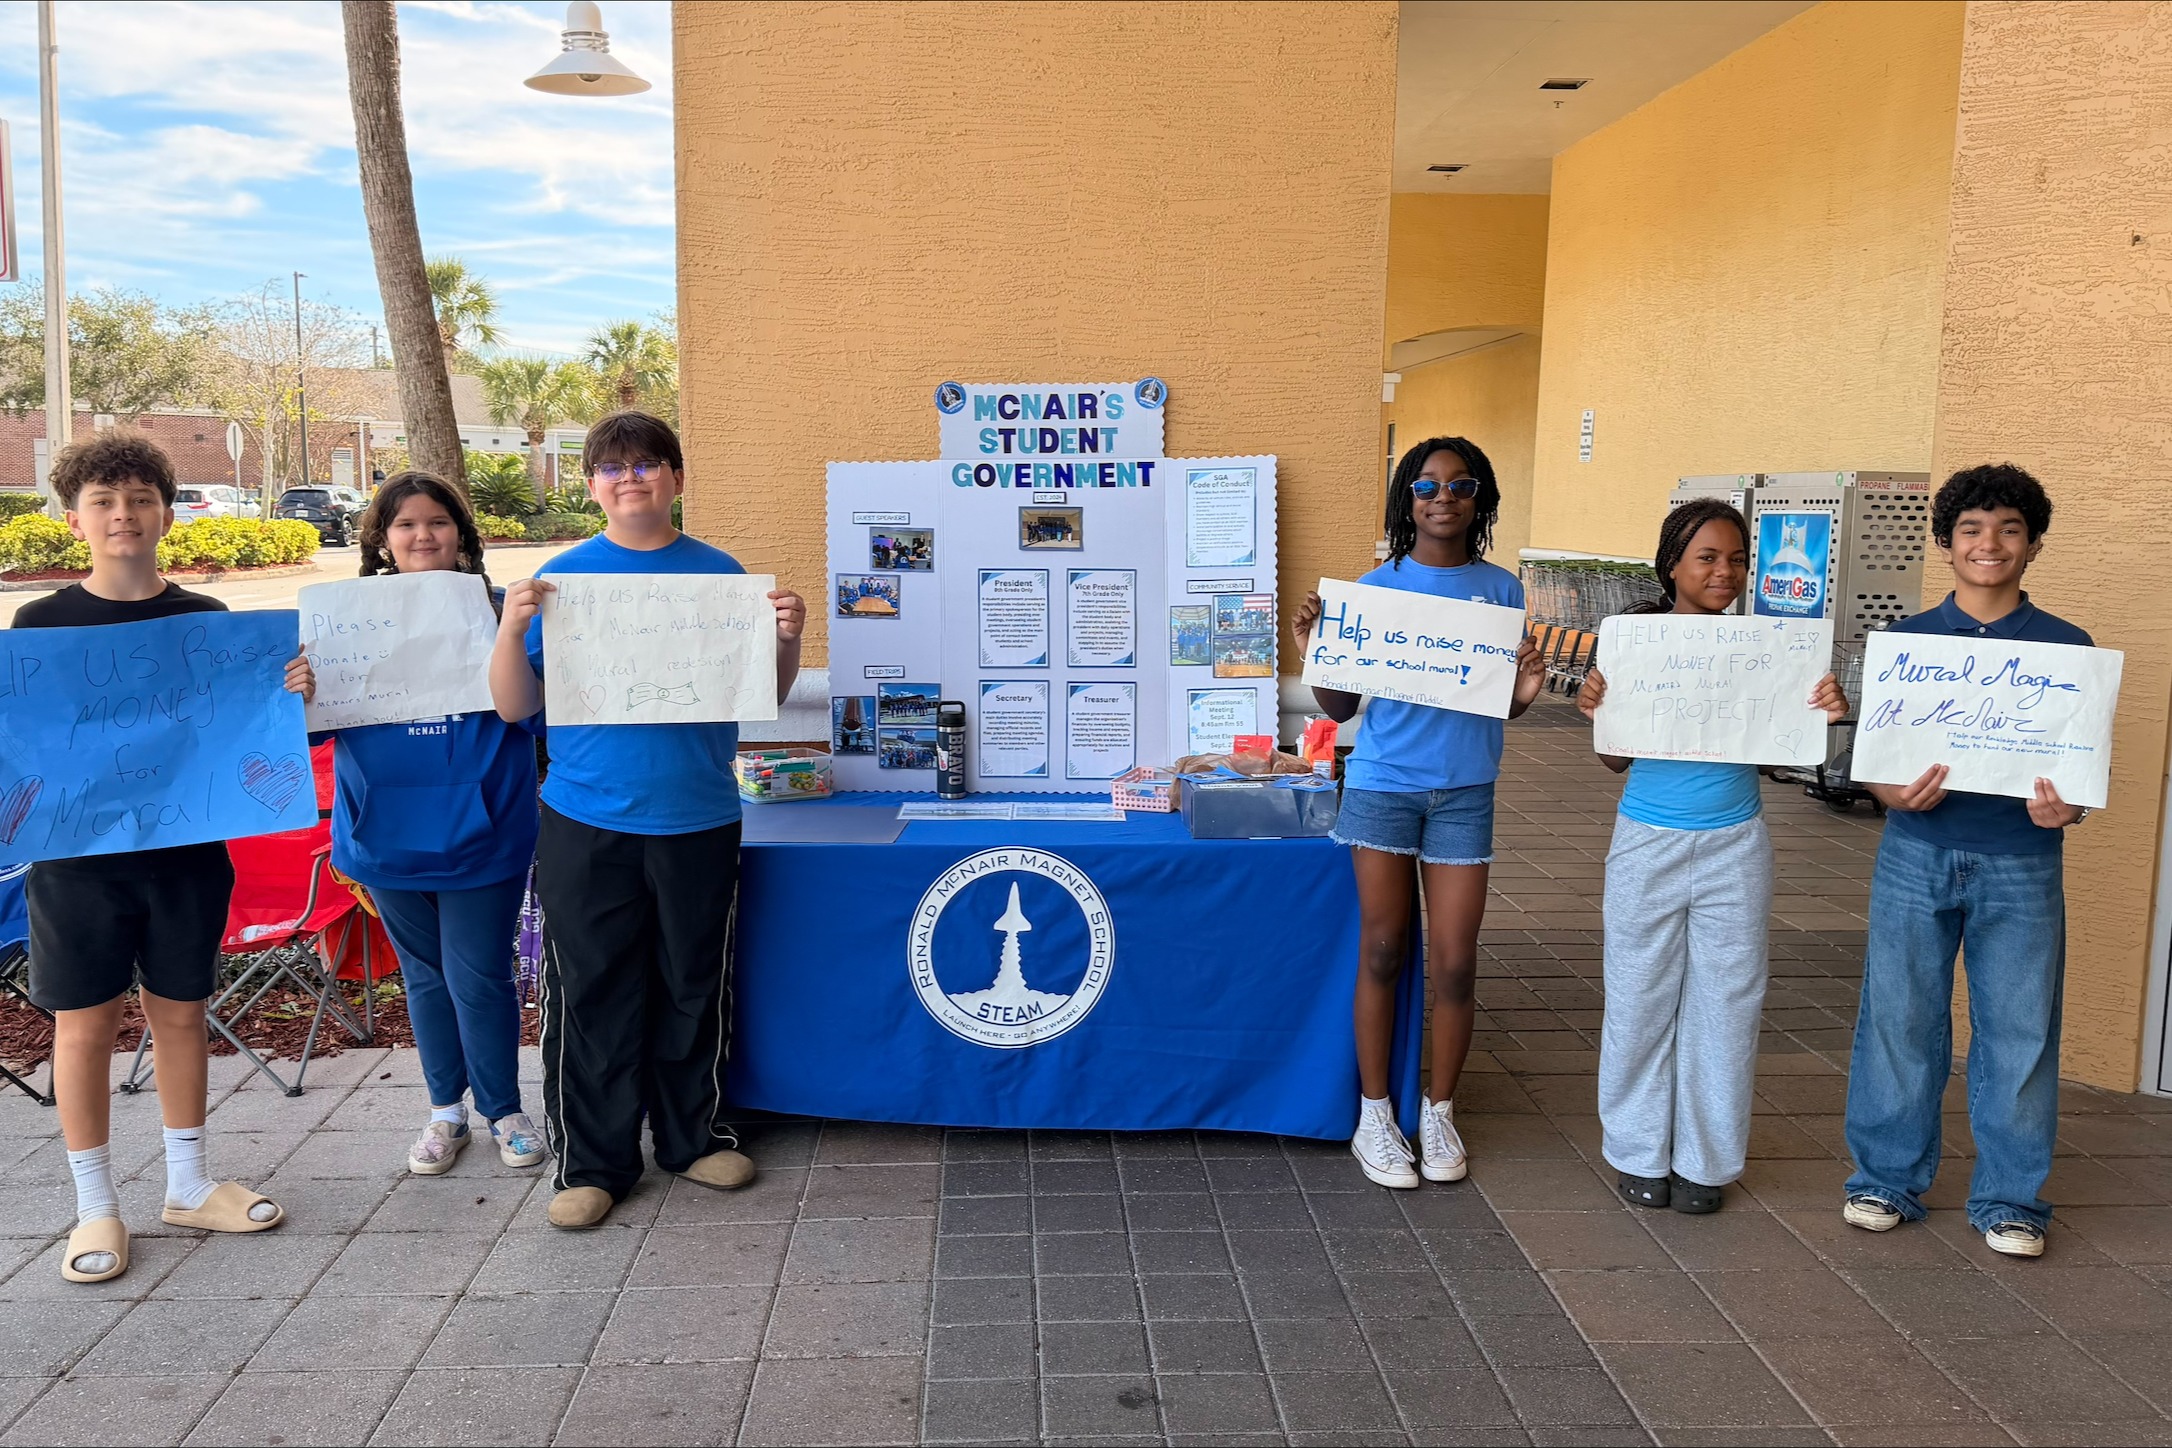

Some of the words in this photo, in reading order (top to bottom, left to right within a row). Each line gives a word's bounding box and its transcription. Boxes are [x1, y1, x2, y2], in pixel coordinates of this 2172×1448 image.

[974, 389, 1125, 422] MCNAIR'S
[978, 427, 1119, 454] STUDENT
[952, 461, 1155, 488] GOVERNMENT
[1220, 480, 1250, 488] Conduct
[1860, 481, 1891, 490] PROPANE
[876, 514, 907, 522] SPEAKERS
[994, 579, 1033, 587] President
[1074, 583, 1091, 591] Vice
[1092, 583, 1129, 591] President
[1225, 582, 1250, 590] SERVICE
[1762, 574, 1817, 598] AmeriGas
[556, 581, 597, 615] Help
[647, 582, 700, 603] Raise
[312, 613, 398, 640] Please
[1317, 599, 1372, 651] Help
[1384, 629, 1409, 645] us
[1416, 634, 1465, 652] raise
[1472, 642, 1519, 664] money
[1615, 619, 1669, 651] HELP
[1683, 628, 1704, 641] US
[1716, 626, 1762, 644] RAISE
[182, 625, 289, 669] Raise
[307, 652, 371, 669] Donate
[666, 654, 732, 678] redesign
[1312, 645, 1348, 666] for
[1355, 656, 1380, 667] our
[1386, 658, 1426, 673] school
[1429, 664, 1472, 686] mural!
[1660, 654, 1716, 674] MONEY
[1729, 653, 1773, 674] FOR
[339, 671, 369, 685] for
[1321, 674, 1349, 691] Ronald
[1384, 686, 1415, 701] Magnet
[1415, 693, 1445, 706] Middle
[1878, 652, 1975, 684] Mural
[1981, 656, 2081, 710] Magic
[995, 694, 1033, 703] Secretary
[324, 716, 366, 730] Thank
[1652, 692, 1777, 733] PROJECT!
[1865, 698, 1903, 732] At
[1972, 741, 1982, 749] to
[115, 743, 163, 783] for
[948, 734, 964, 786] BRAVO
[43, 771, 214, 850] Mural
[916, 903, 938, 989] RONALD
[1020, 853, 1095, 904] MAGNET
[1082, 911, 1107, 993] SCHOOL
[519, 956, 531, 980] GCU
[943, 1008, 979, 1033] LAUNCH
[979, 1030, 1005, 1039] HERE
[1030, 1004, 1081, 1036] ANYWHERE!
[977, 1001, 1044, 1023] STEAM
